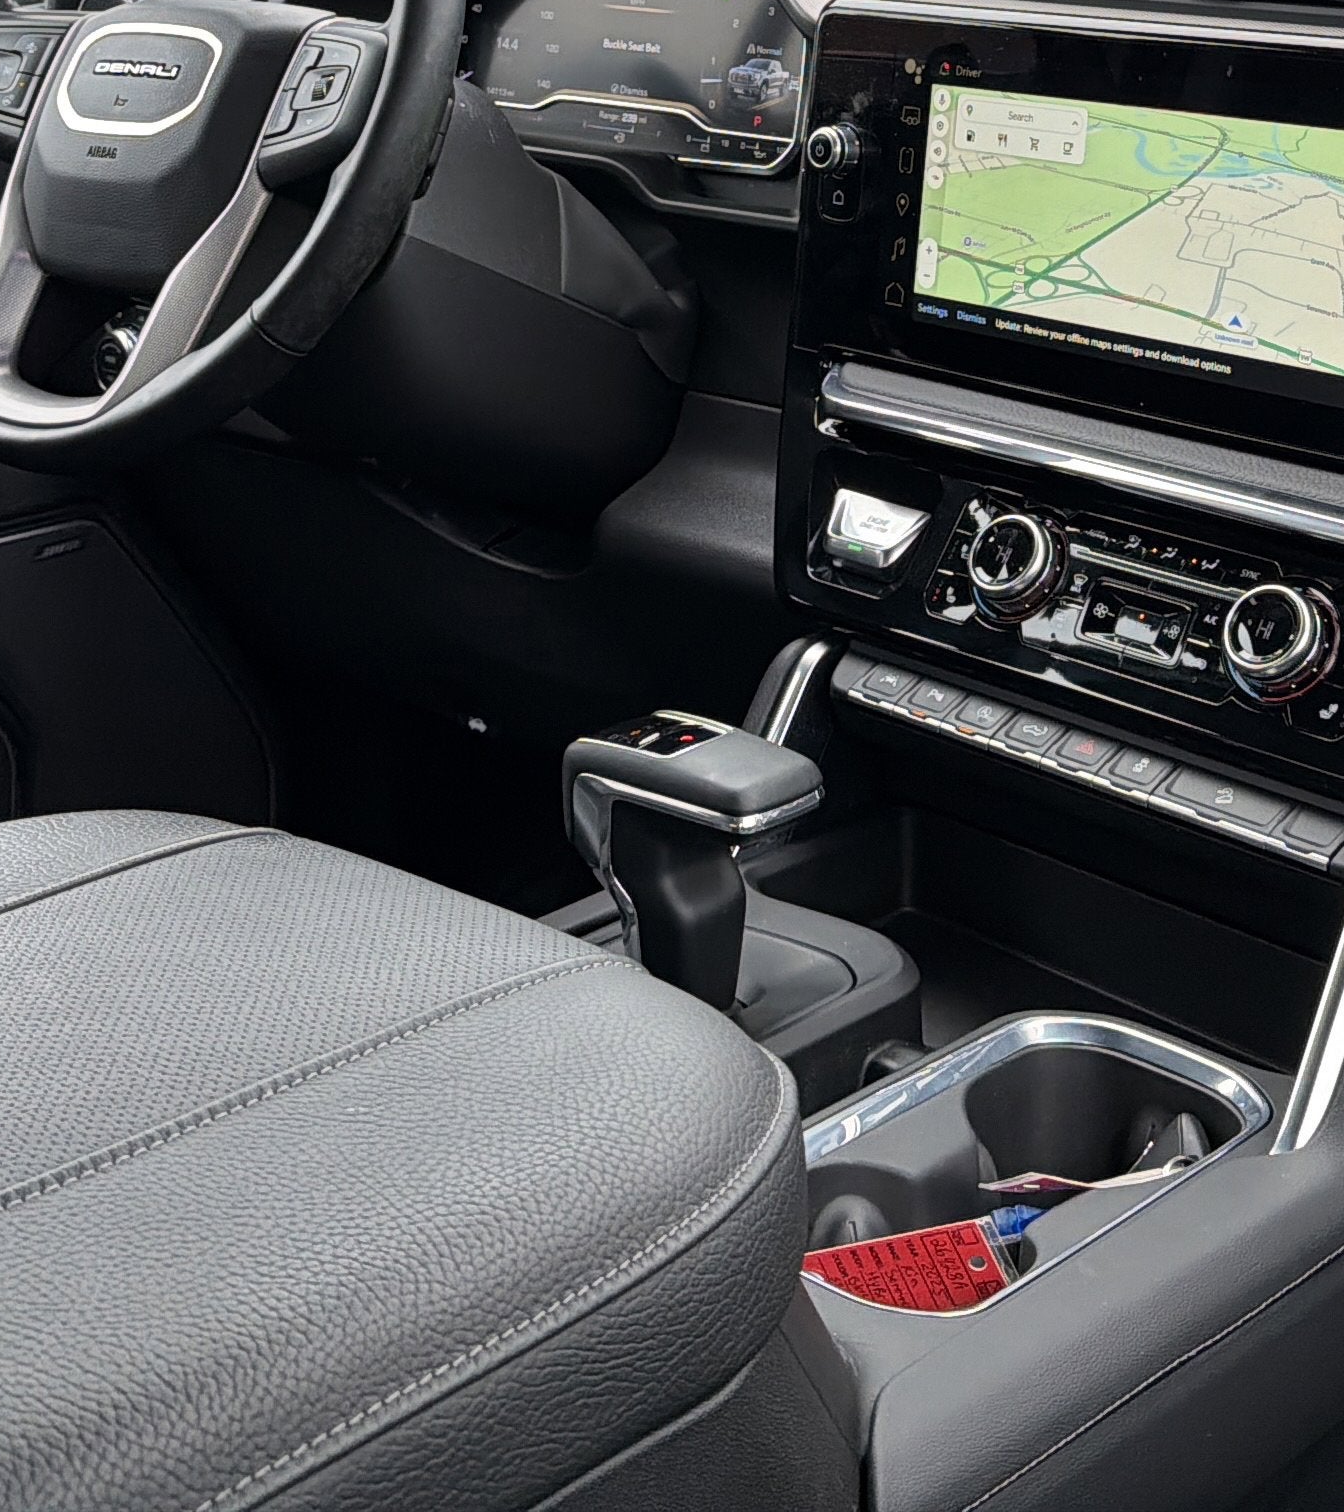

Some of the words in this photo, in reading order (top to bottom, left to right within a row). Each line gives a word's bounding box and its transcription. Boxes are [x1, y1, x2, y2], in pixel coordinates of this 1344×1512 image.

[768, 6, 776, 16] 3
[496, 37, 519, 51] 14.4
[602, 38, 628, 51] Buckle
[628, 40, 644, 52] Seat
[645, 43, 662, 54] Belt
[756, 45, 783, 56] Normal
[93, 61, 180, 78] DENALI
[956, 65, 983, 79] Driver
[537, 79, 553, 89] 140
[619, 85, 649, 97] Dismiss
[753, 115, 763, 127] P
[1007, 111, 1034, 124] Search
[86, 146, 118, 159] AIRBAG
[917, 302, 949, 319] Settings
[957, 310, 987, 325] Dismiss
[995, 318, 1022, 333] Update:
[1023, 324, 1049, 337] Review
[1049, 330, 1067, 341] your
[1067, 332, 1090, 346] offline
[1090, 339, 1112, 352] maps
[1112, 343, 1144, 358] settings
[1144, 349, 1161, 361] and
[1161, 352, 1200, 369] download
[1200, 360, 1232, 375] options
[1239, 568, 1262, 581] SYNC
[1203, 615, 1220, 626] A/C
[1255, 618, 1275, 640] HI
